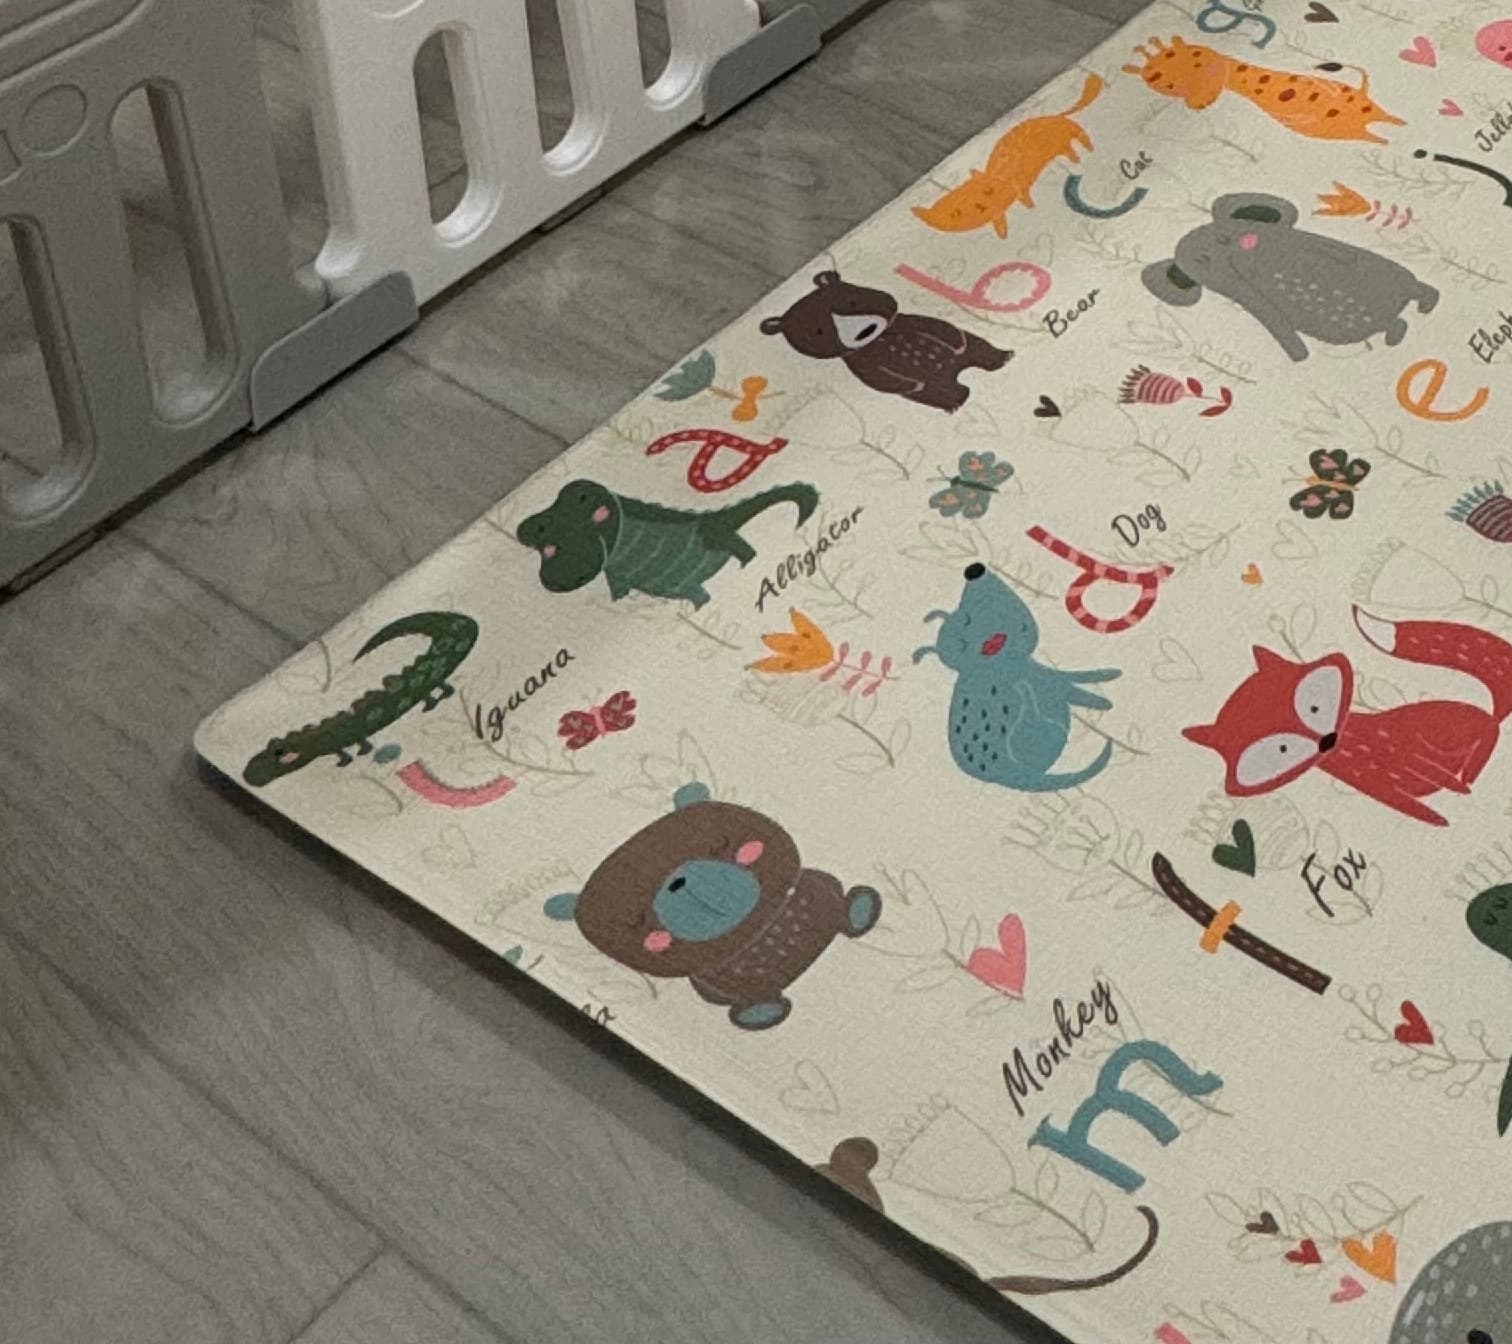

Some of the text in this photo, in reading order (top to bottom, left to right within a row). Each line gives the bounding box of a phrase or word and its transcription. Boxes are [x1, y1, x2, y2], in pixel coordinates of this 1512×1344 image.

[1041, 286, 1102, 339] Bear
[1396, 358, 1490, 422] e
[755, 505, 865, 614] Alligator
[1111, 501, 1168, 549] Dog
[1025, 524, 1175, 634] d
[473, 646, 577, 744] Iguana
[1301, 845, 1369, 918] Fox
[1000, 974, 1120, 1117] Monkey
[1027, 1039, 1224, 1195] m
